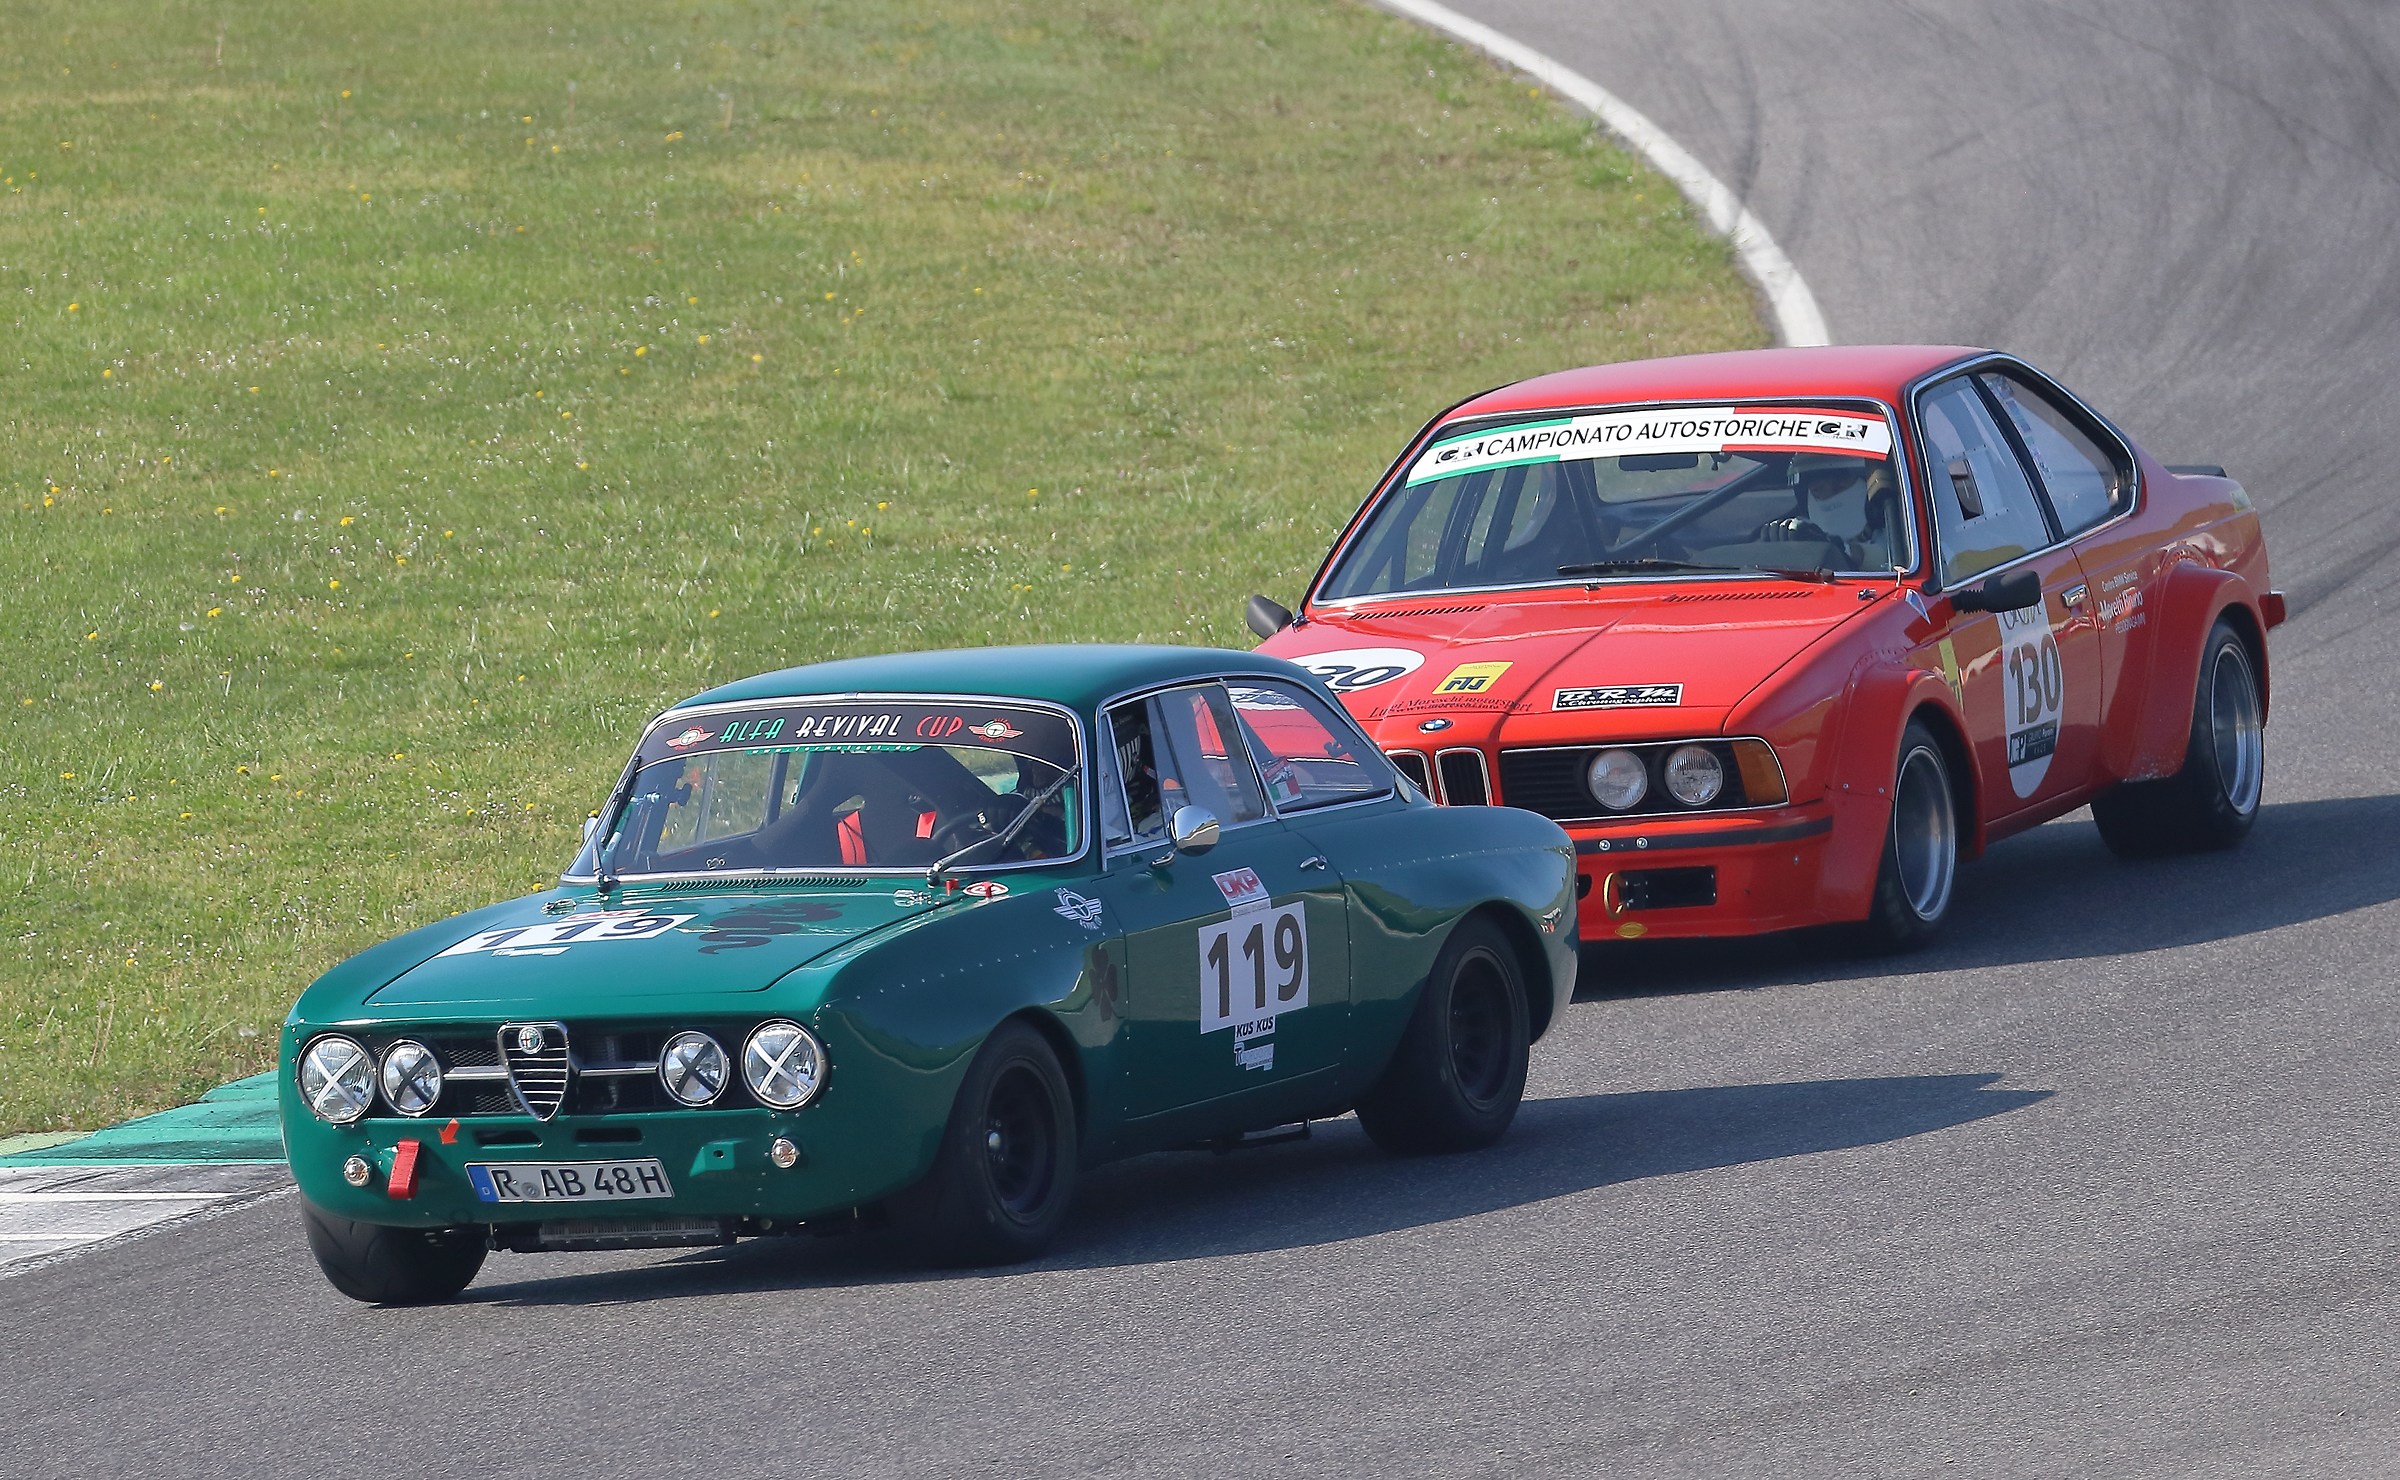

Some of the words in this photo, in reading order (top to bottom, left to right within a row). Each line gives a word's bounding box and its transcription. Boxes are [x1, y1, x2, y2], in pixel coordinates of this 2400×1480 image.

[1486, 424, 1633, 457] CAMPIONATO
[1635, 419, 1812, 440] AUTOSTORICHE
[2009, 633, 2061, 725] 130
[719, 717, 786, 743] ALFA
[795, 713, 902, 739] REVIVAL
[915, 715, 964, 738] CUP
[478, 917, 675, 949] 119
[1207, 913, 1304, 1019] 119
[1236, 1021, 1254, 1038] KUS
[1256, 1015, 1274, 1033] KUS
[490, 1168, 520, 1198] R
[540, 1168, 586, 1197] AB
